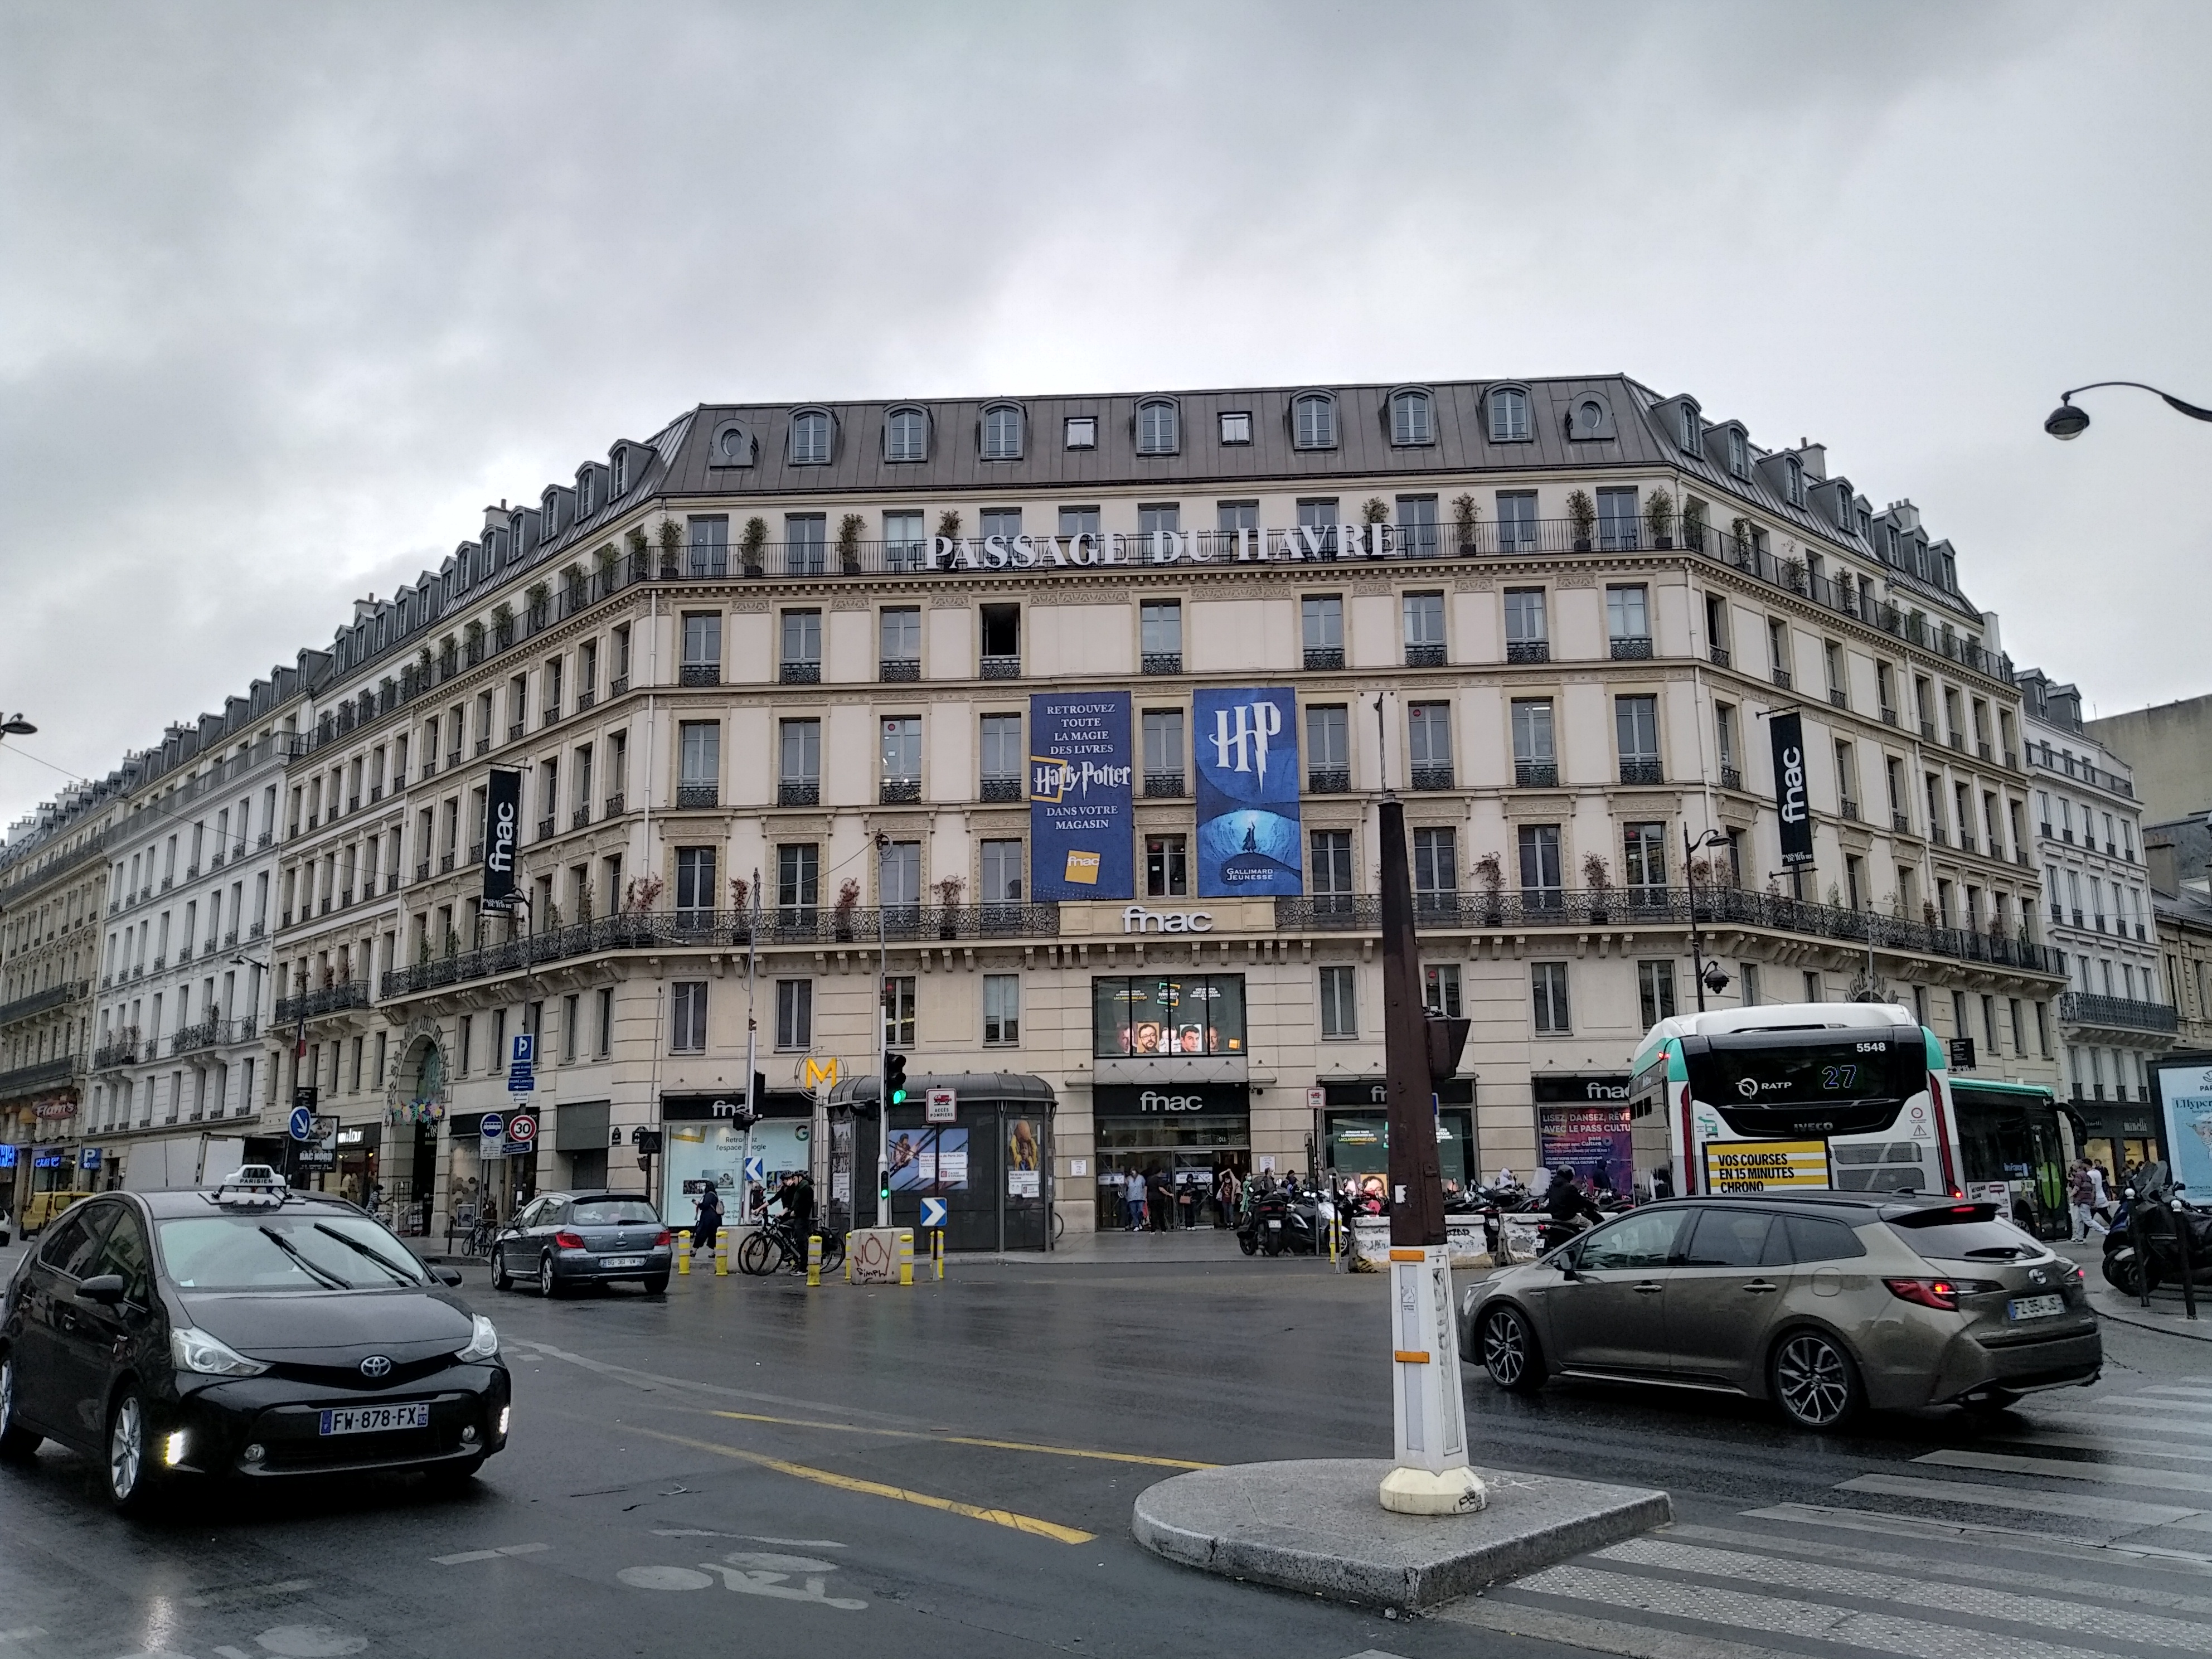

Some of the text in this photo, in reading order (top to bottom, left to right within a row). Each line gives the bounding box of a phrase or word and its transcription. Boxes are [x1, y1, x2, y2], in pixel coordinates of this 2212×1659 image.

[924, 522, 1397, 570] PASSAGE DU HAVRE
[1047, 704, 1115, 714] RETROUVEZ
[1061, 717, 1101, 727] TOUTE
[1054, 731, 1109, 741] LA MAGIE
[1050, 745, 1113, 754] DES LIVRES
[1209, 701, 1281, 794] HP
[1034, 761, 1131, 800] Harry Potter
[1782, 746, 1806, 823] fnac
[1046, 806, 1118, 816] DANS VOTRE
[1055, 819, 1109, 830] MAGASIN
[489, 802, 514, 872] fnac
[1068, 856, 1100, 866] fnac
[1122, 905, 1212, 933] fnac
[1856, 1042, 1886, 1052] 5548
[806, 1058, 837, 1090] M
[1822, 1065, 1857, 1089] 27
[1140, 1091, 1203, 1111] fnac
[712, 1100, 748, 1117] fna
[1569, 1114, 1606, 1122] DANSEZ,
[1608, 1112, 1631, 1121] RÊVE
[516, 1123, 531, 1134] 30
[1794, 1122, 1833, 1132] IVECO
[84, 1149, 96, 1162] P
[1718, 1153, 1788, 1166] VOS COURSES
[243, 1168, 271, 1177] TAXI
[1719, 1167, 1794, 1180] EN 15 MINUTES
[1720, 1181, 1764, 1193] CHRONO
[333, 1407, 416, 1430] FW-878-FX
